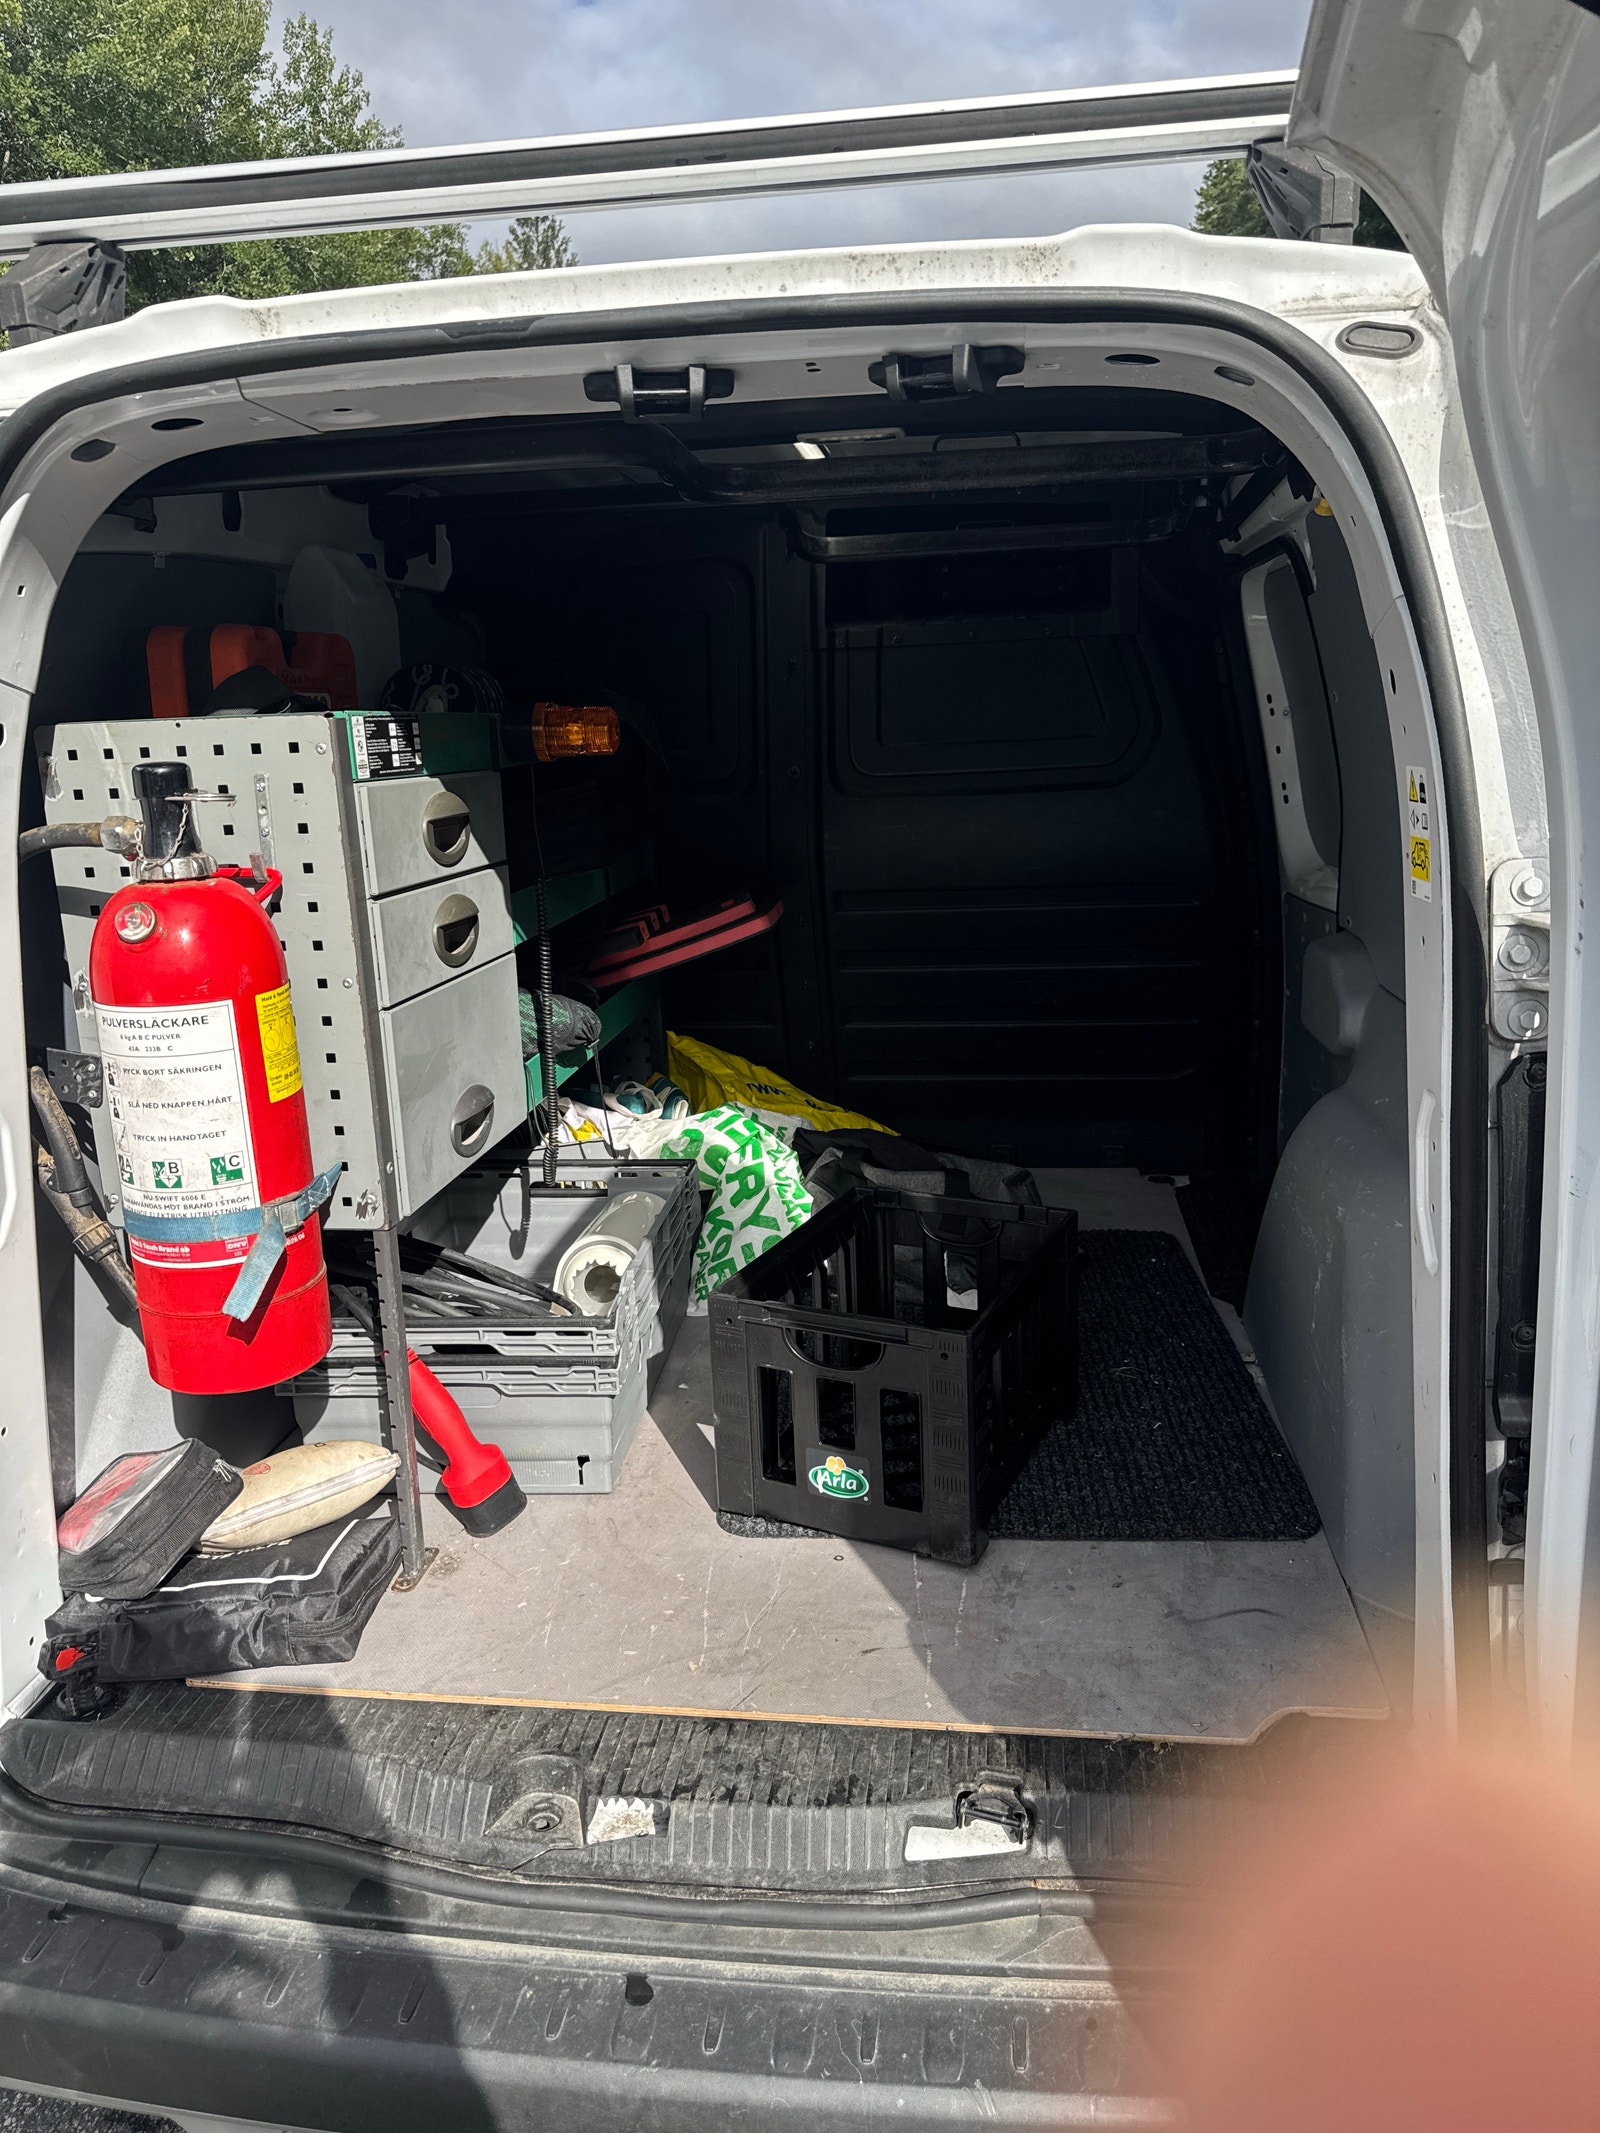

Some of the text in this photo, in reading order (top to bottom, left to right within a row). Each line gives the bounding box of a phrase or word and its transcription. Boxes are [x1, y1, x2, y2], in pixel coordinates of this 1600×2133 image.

[101, 1015, 210, 1029] PULVERSLÄCKARE
[151, 1033, 181, 1041] PULVER
[143, 1068, 166, 1076] BORT
[168, 1063, 222, 1076] SÄKRINGEN
[128, 1099, 141, 1108] SLÅ
[161, 1098, 205, 1110] KNAPPEN
[133, 1130, 227, 1143] TRYCK IN HANDTAGET
[228, 1155, 240, 1167] C
[168, 1162, 179, 1174] B
[181, 1194, 199, 1202] 6006
[183, 1201, 213, 1211] BRAND
[817, 1468, 857, 1494] Arla
